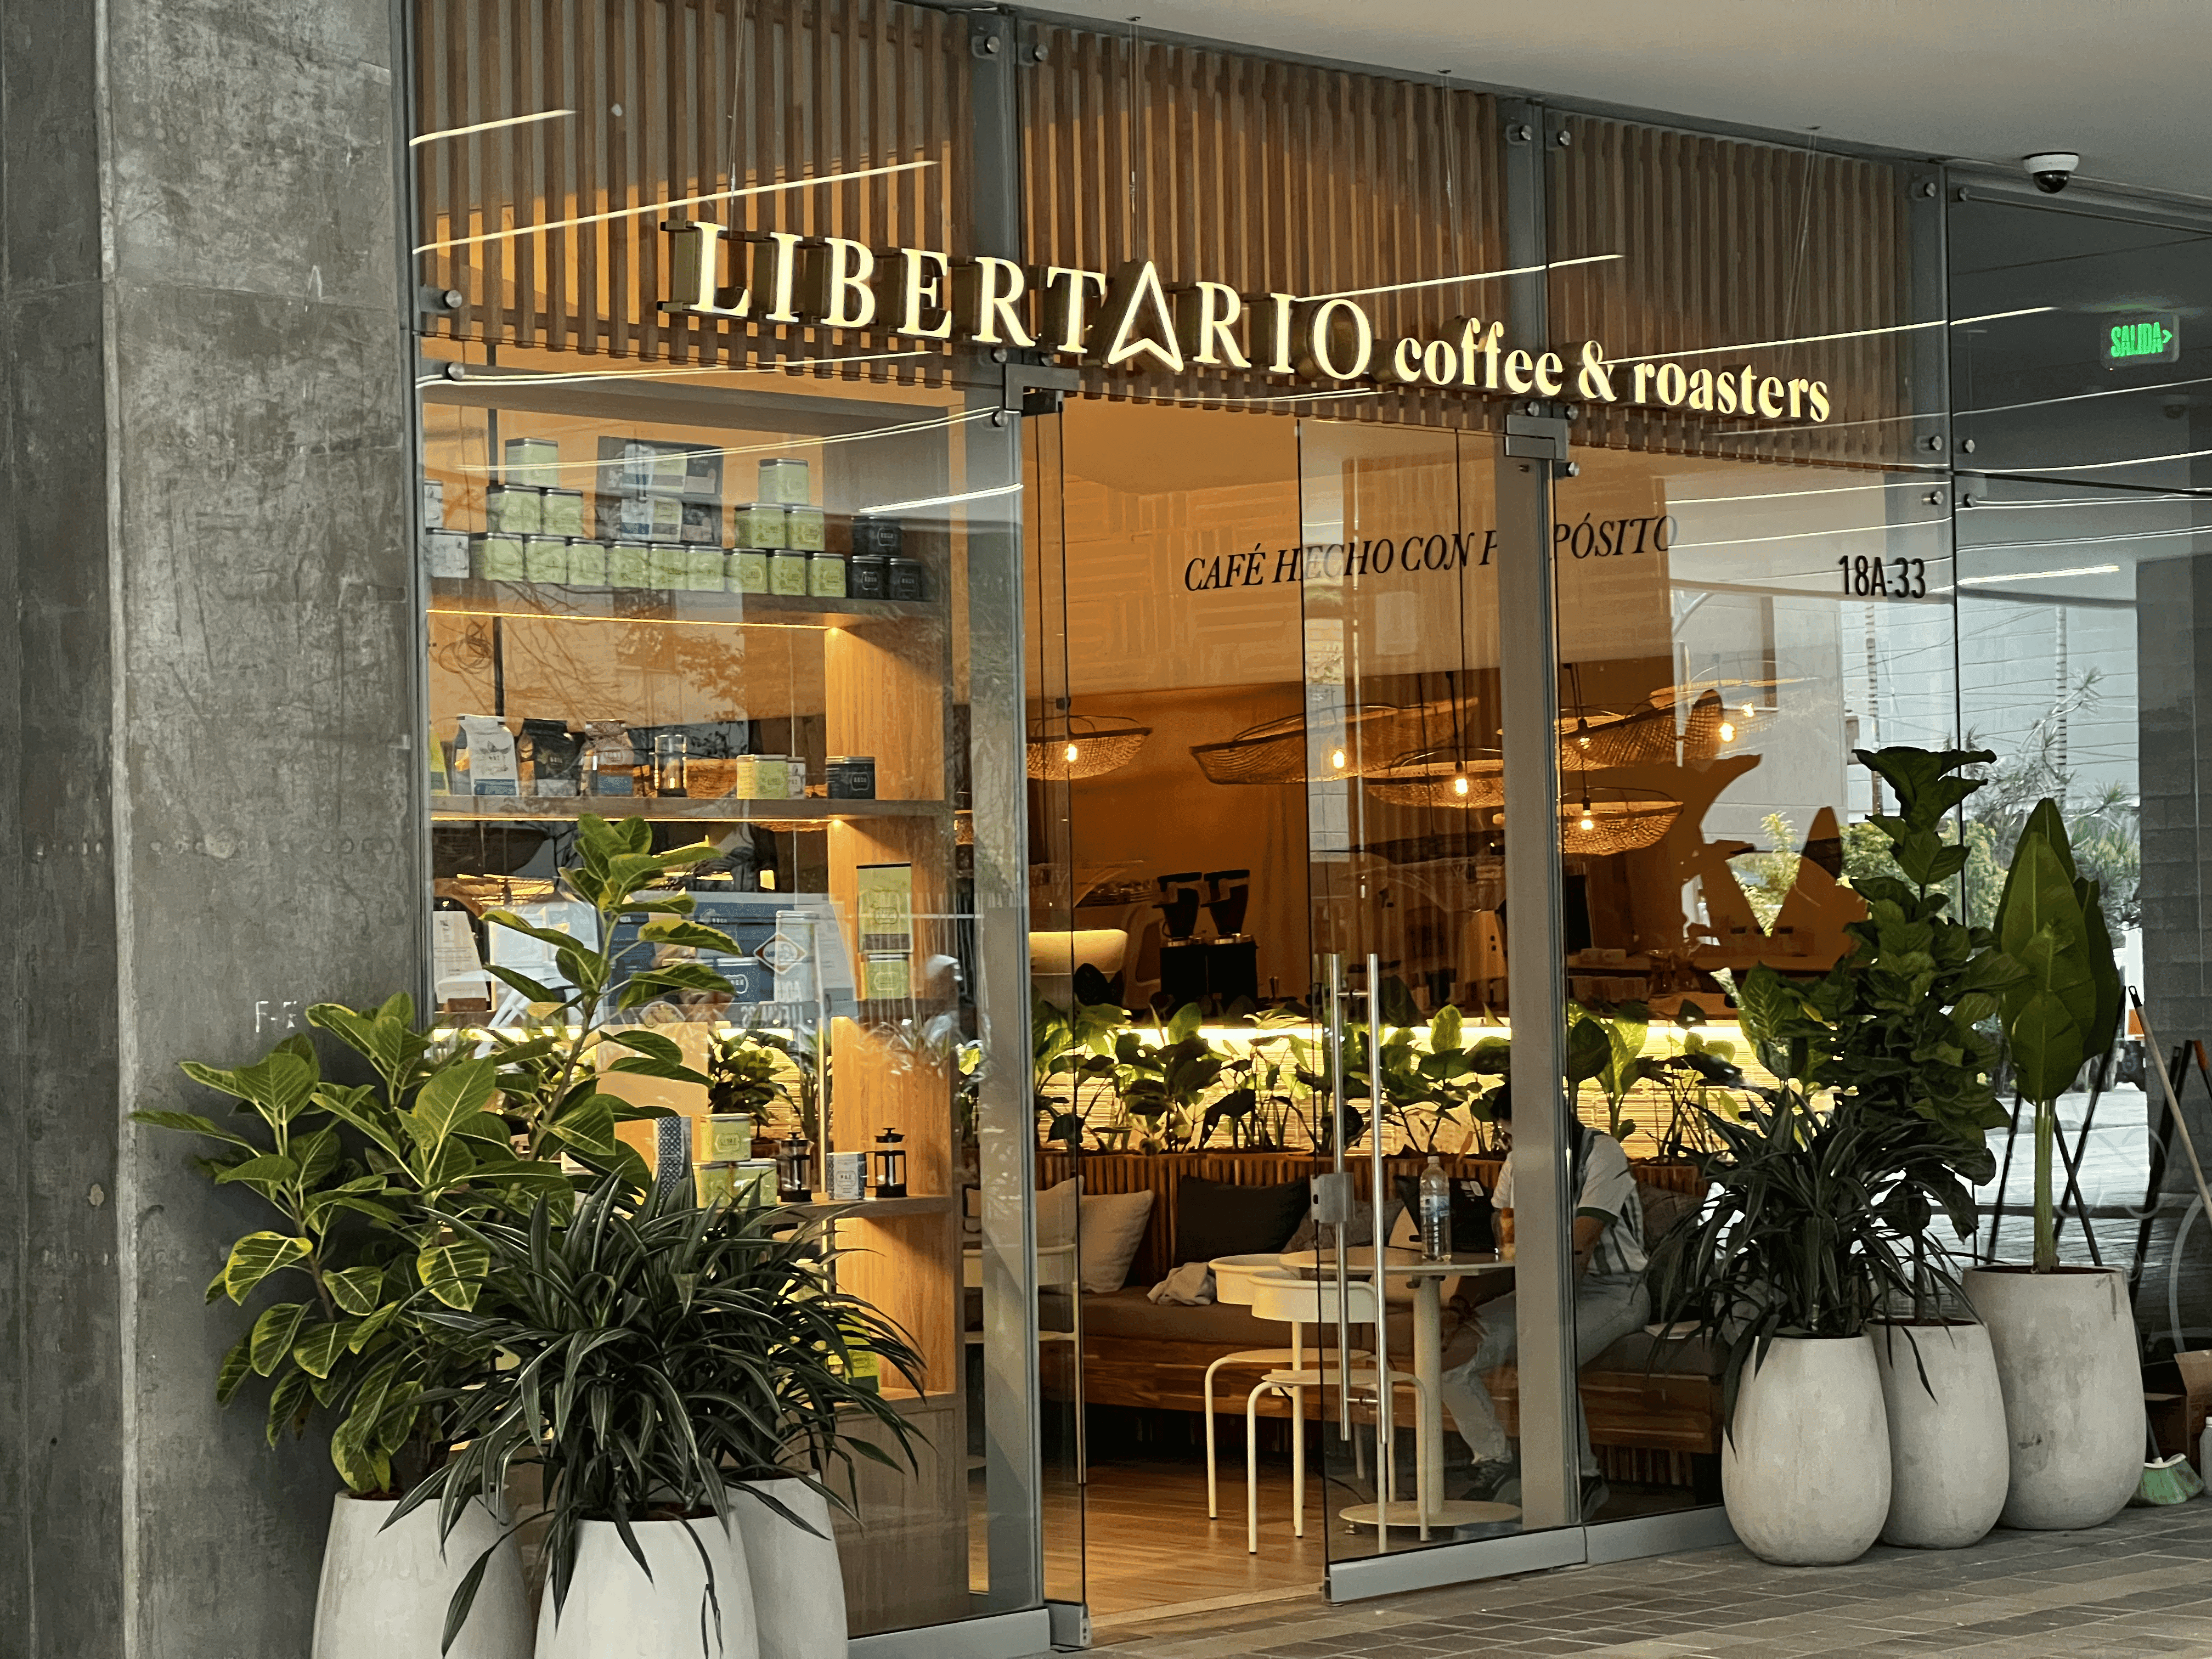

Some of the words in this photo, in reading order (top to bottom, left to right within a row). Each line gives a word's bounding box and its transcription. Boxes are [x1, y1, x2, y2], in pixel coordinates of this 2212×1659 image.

[689, 221, 1372, 380] LIBERTARIO
[1395, 317, 1564, 396] coffee
[1577, 340, 1617, 402] &
[1633, 363, 1830, 422] roasters
[2111, 321, 2163, 357] SALIDA
[1184, 543, 1267, 591] CAFÉ
[1272, 538, 1394, 583] HECHO
[1401, 532, 1475, 572] CON
[1479, 512, 1678, 566] PPÓSITO
[1838, 555, 1926, 599] 18A-33
